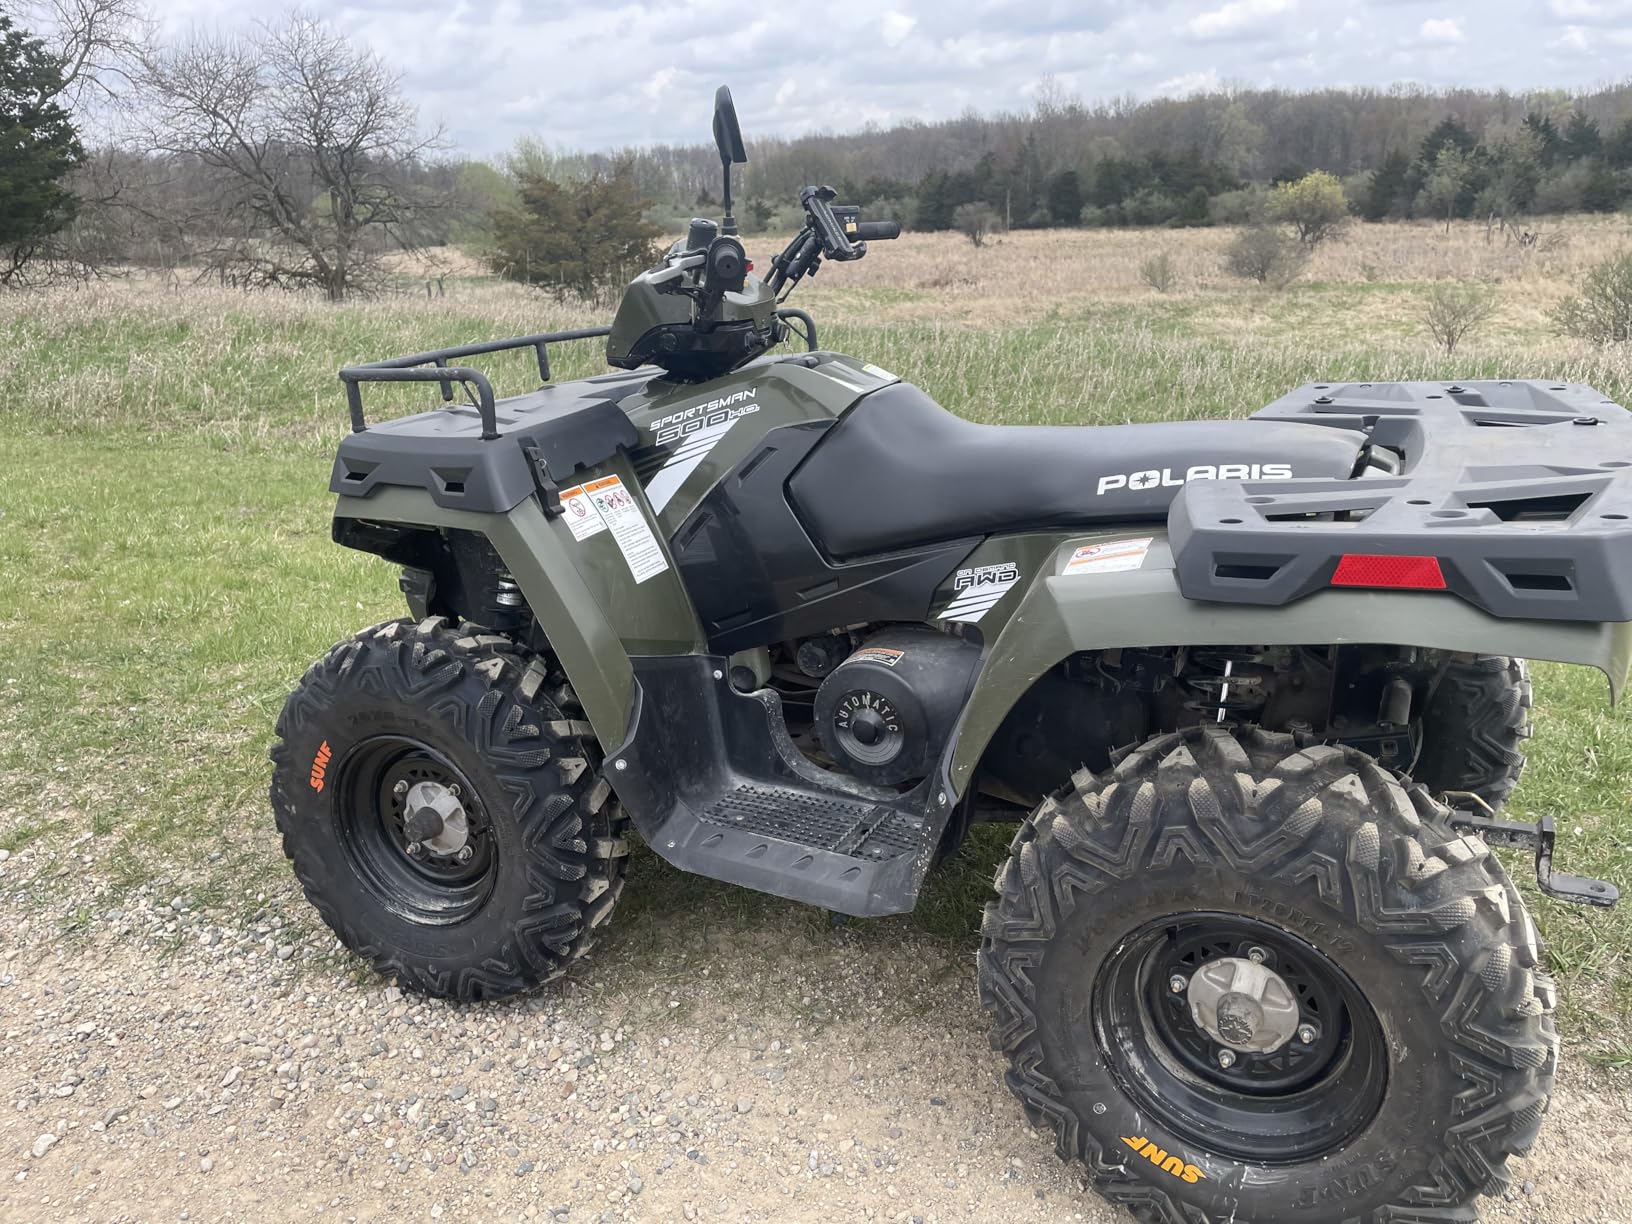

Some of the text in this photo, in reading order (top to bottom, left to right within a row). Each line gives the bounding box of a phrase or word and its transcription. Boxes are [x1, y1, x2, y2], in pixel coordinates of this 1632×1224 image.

[649, 387, 757, 432] SPORTSMAN
[655, 408, 731, 447] 500
[1097, 464, 1293, 496] POLARIS
[954, 568, 1019, 591] AWD
[838, 693, 899, 733] AUTOMATIC
[310, 739, 333, 793] SUNF
[1119, 1135, 1207, 1184] SUNF
